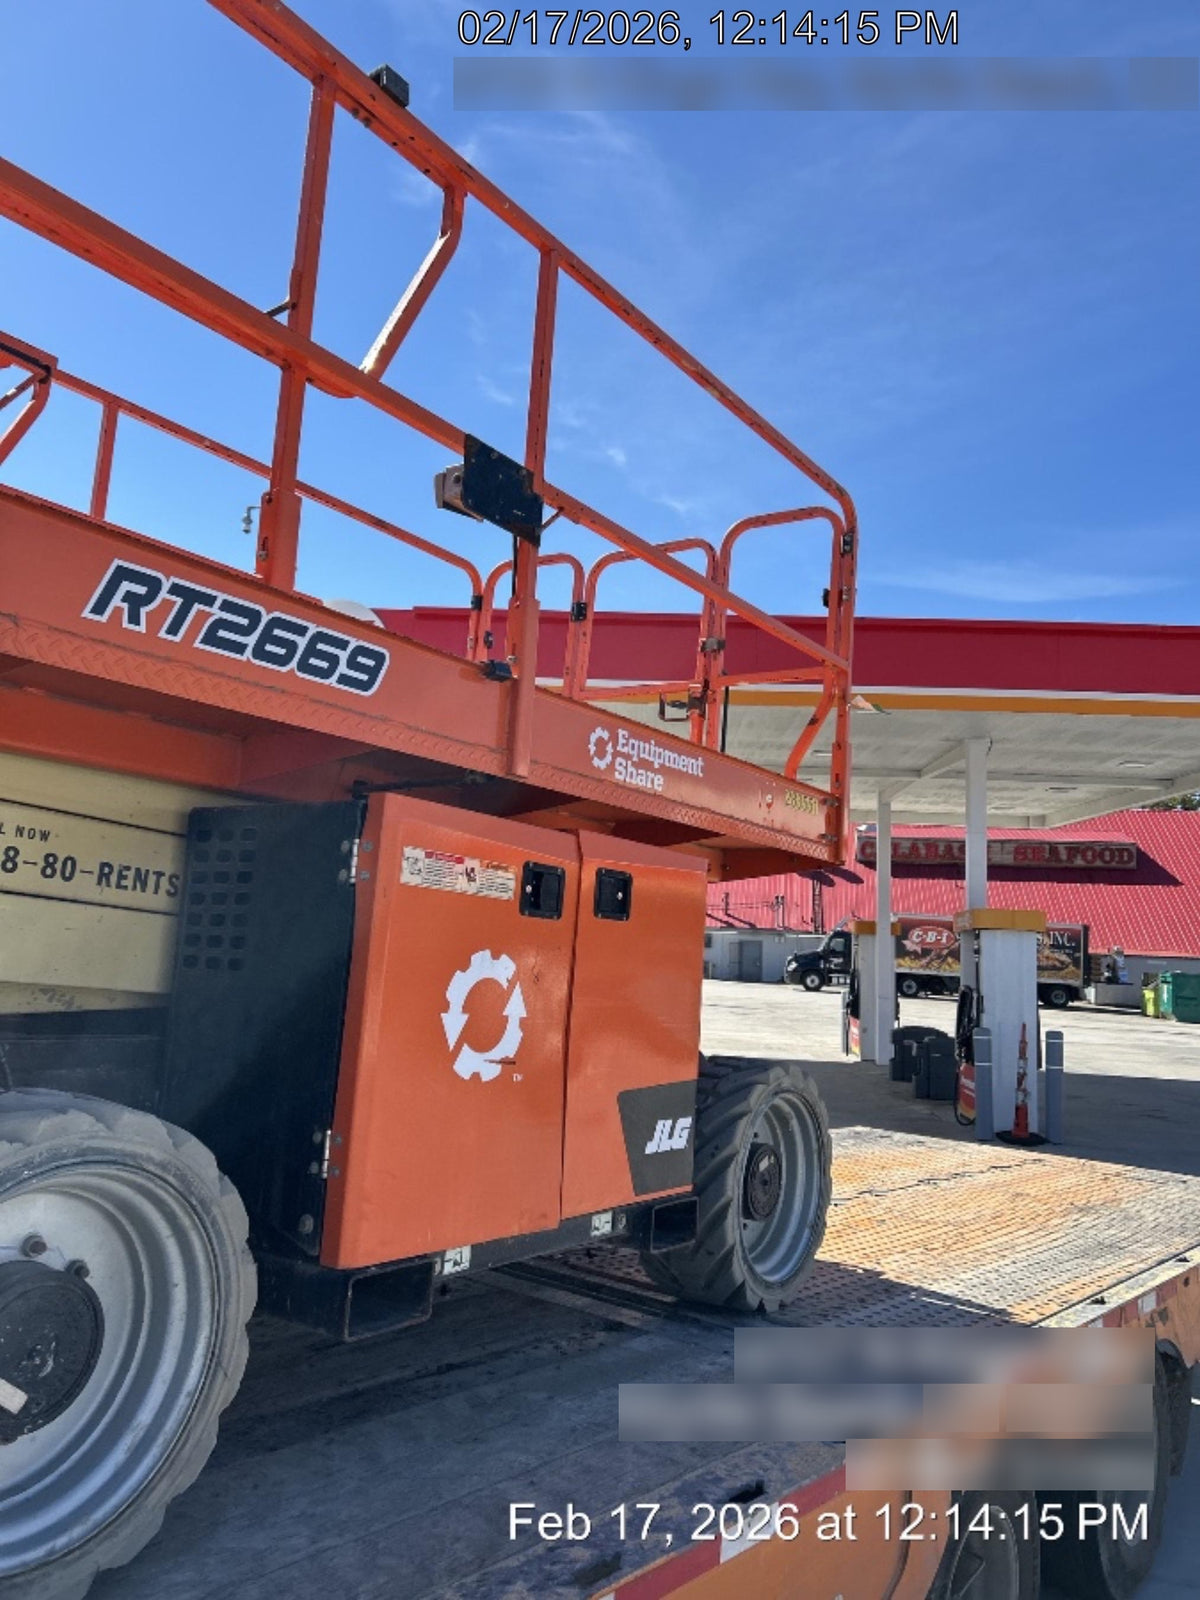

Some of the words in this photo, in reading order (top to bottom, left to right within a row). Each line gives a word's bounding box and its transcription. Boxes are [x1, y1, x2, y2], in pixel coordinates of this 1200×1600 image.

[82, 558, 390, 697] RT2669
[617, 728, 704, 777] Equipment
[614, 756, 664, 792] Share
[15, 825, 51, 842] NOW
[1013, 845, 1136, 866] SEAFOOD
[912, 930, 949, 944] C-B-I
[645, 1116, 693, 1154] JLG
